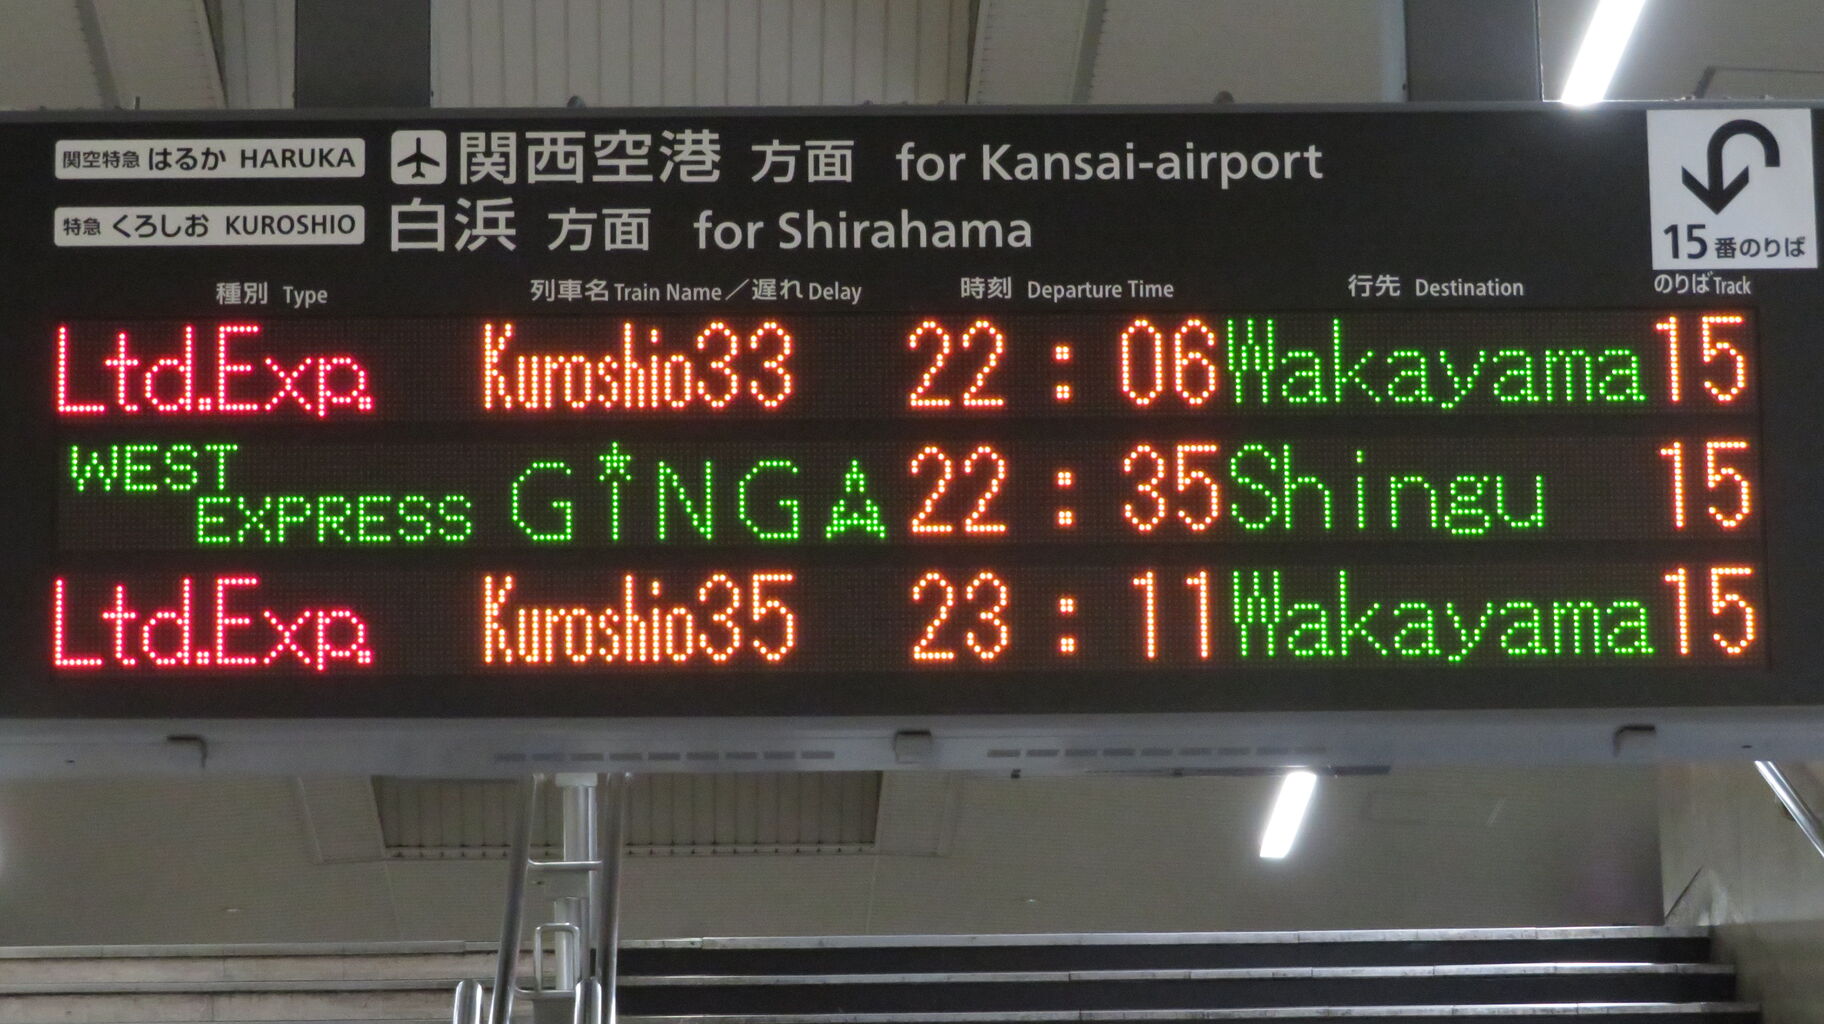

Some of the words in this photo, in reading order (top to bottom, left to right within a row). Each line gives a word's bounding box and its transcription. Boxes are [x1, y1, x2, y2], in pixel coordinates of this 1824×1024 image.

[62, 150, 140, 169] 関空特急
[148, 148, 226, 171] はるか
[240, 148, 356, 169] HARUKA
[460, 129, 721, 185] 関西空港
[751, 139, 854, 183] 方面
[896, 142, 966, 182] for
[982, 142, 1323, 189] Kansai-airport
[63, 218, 101, 236] 特急
[111, 214, 209, 238] くろしお
[226, 214, 356, 235] KUROSHIO
[390, 198, 516, 252] 白浜
[548, 207, 651, 251] 方面
[694, 210, 763, 249] for
[778, 209, 1032, 250] Shirahama
[1663, 224, 1707, 259] 15
[1714, 235, 1806, 259] 番のりば
[216, 283, 268, 305] 種別
[283, 286, 328, 309] Type
[530, 279, 609, 302] 列車名
[614, 283, 660, 301] Train
[809, 282, 862, 305] Delay
[960, 277, 1012, 300] 時刻
[1028, 280, 1122, 302] Departure
[1128, 280, 1174, 298] Time
[1348, 274, 1400, 297] 行先
[1415, 278, 1523, 297] Destination
[1654, 270, 1713, 294] のりば
[1713, 275, 1751, 295] Track
[1226, 318, 1646, 409] Wakayama
[1655, 316, 1746, 402] 15
[71, 444, 239, 491] WEST
[1230, 444, 1544, 535] Shingu
[1659, 441, 1750, 527] 15
[197, 495, 472, 542] EXPRESS
[1232, 569, 1654, 661] Wakayama
[1664, 567, 1754, 655] 15
